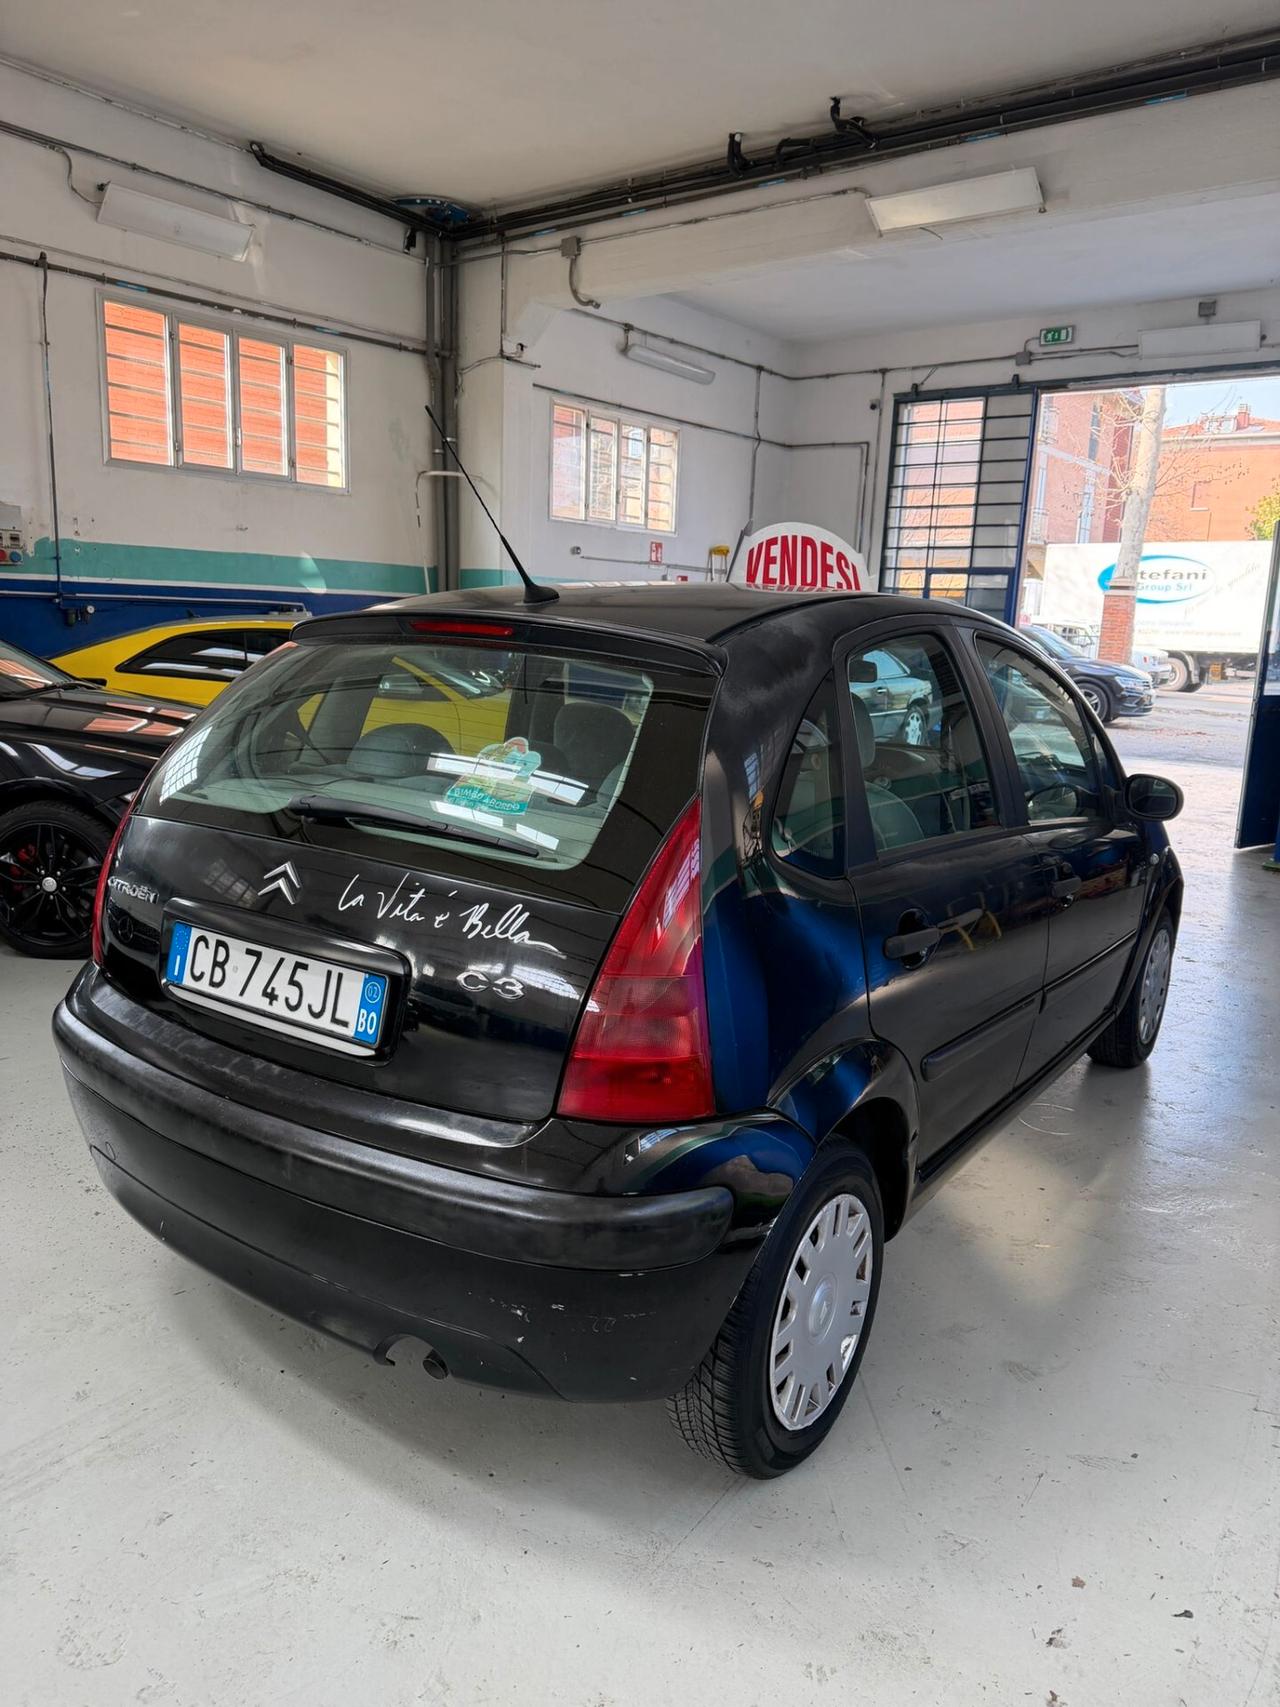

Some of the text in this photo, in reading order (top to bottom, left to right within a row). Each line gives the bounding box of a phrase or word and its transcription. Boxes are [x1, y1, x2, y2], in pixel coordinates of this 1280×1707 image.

[746, 534, 862, 591] VENDESI
[1139, 569, 1207, 580] tefani
[454, 788, 485, 800] BIMBO
[488, 798, 520, 811] BORDO
[107, 876, 159, 904] CITROËN
[338, 874, 365, 911] La
[377, 872, 426, 919] Vita
[459, 903, 567, 959] Bella
[189, 935, 350, 1029] CB 745JL
[367, 985, 379, 999] 02
[456, 969, 526, 1000] C3
[357, 1008, 377, 1035] BO
